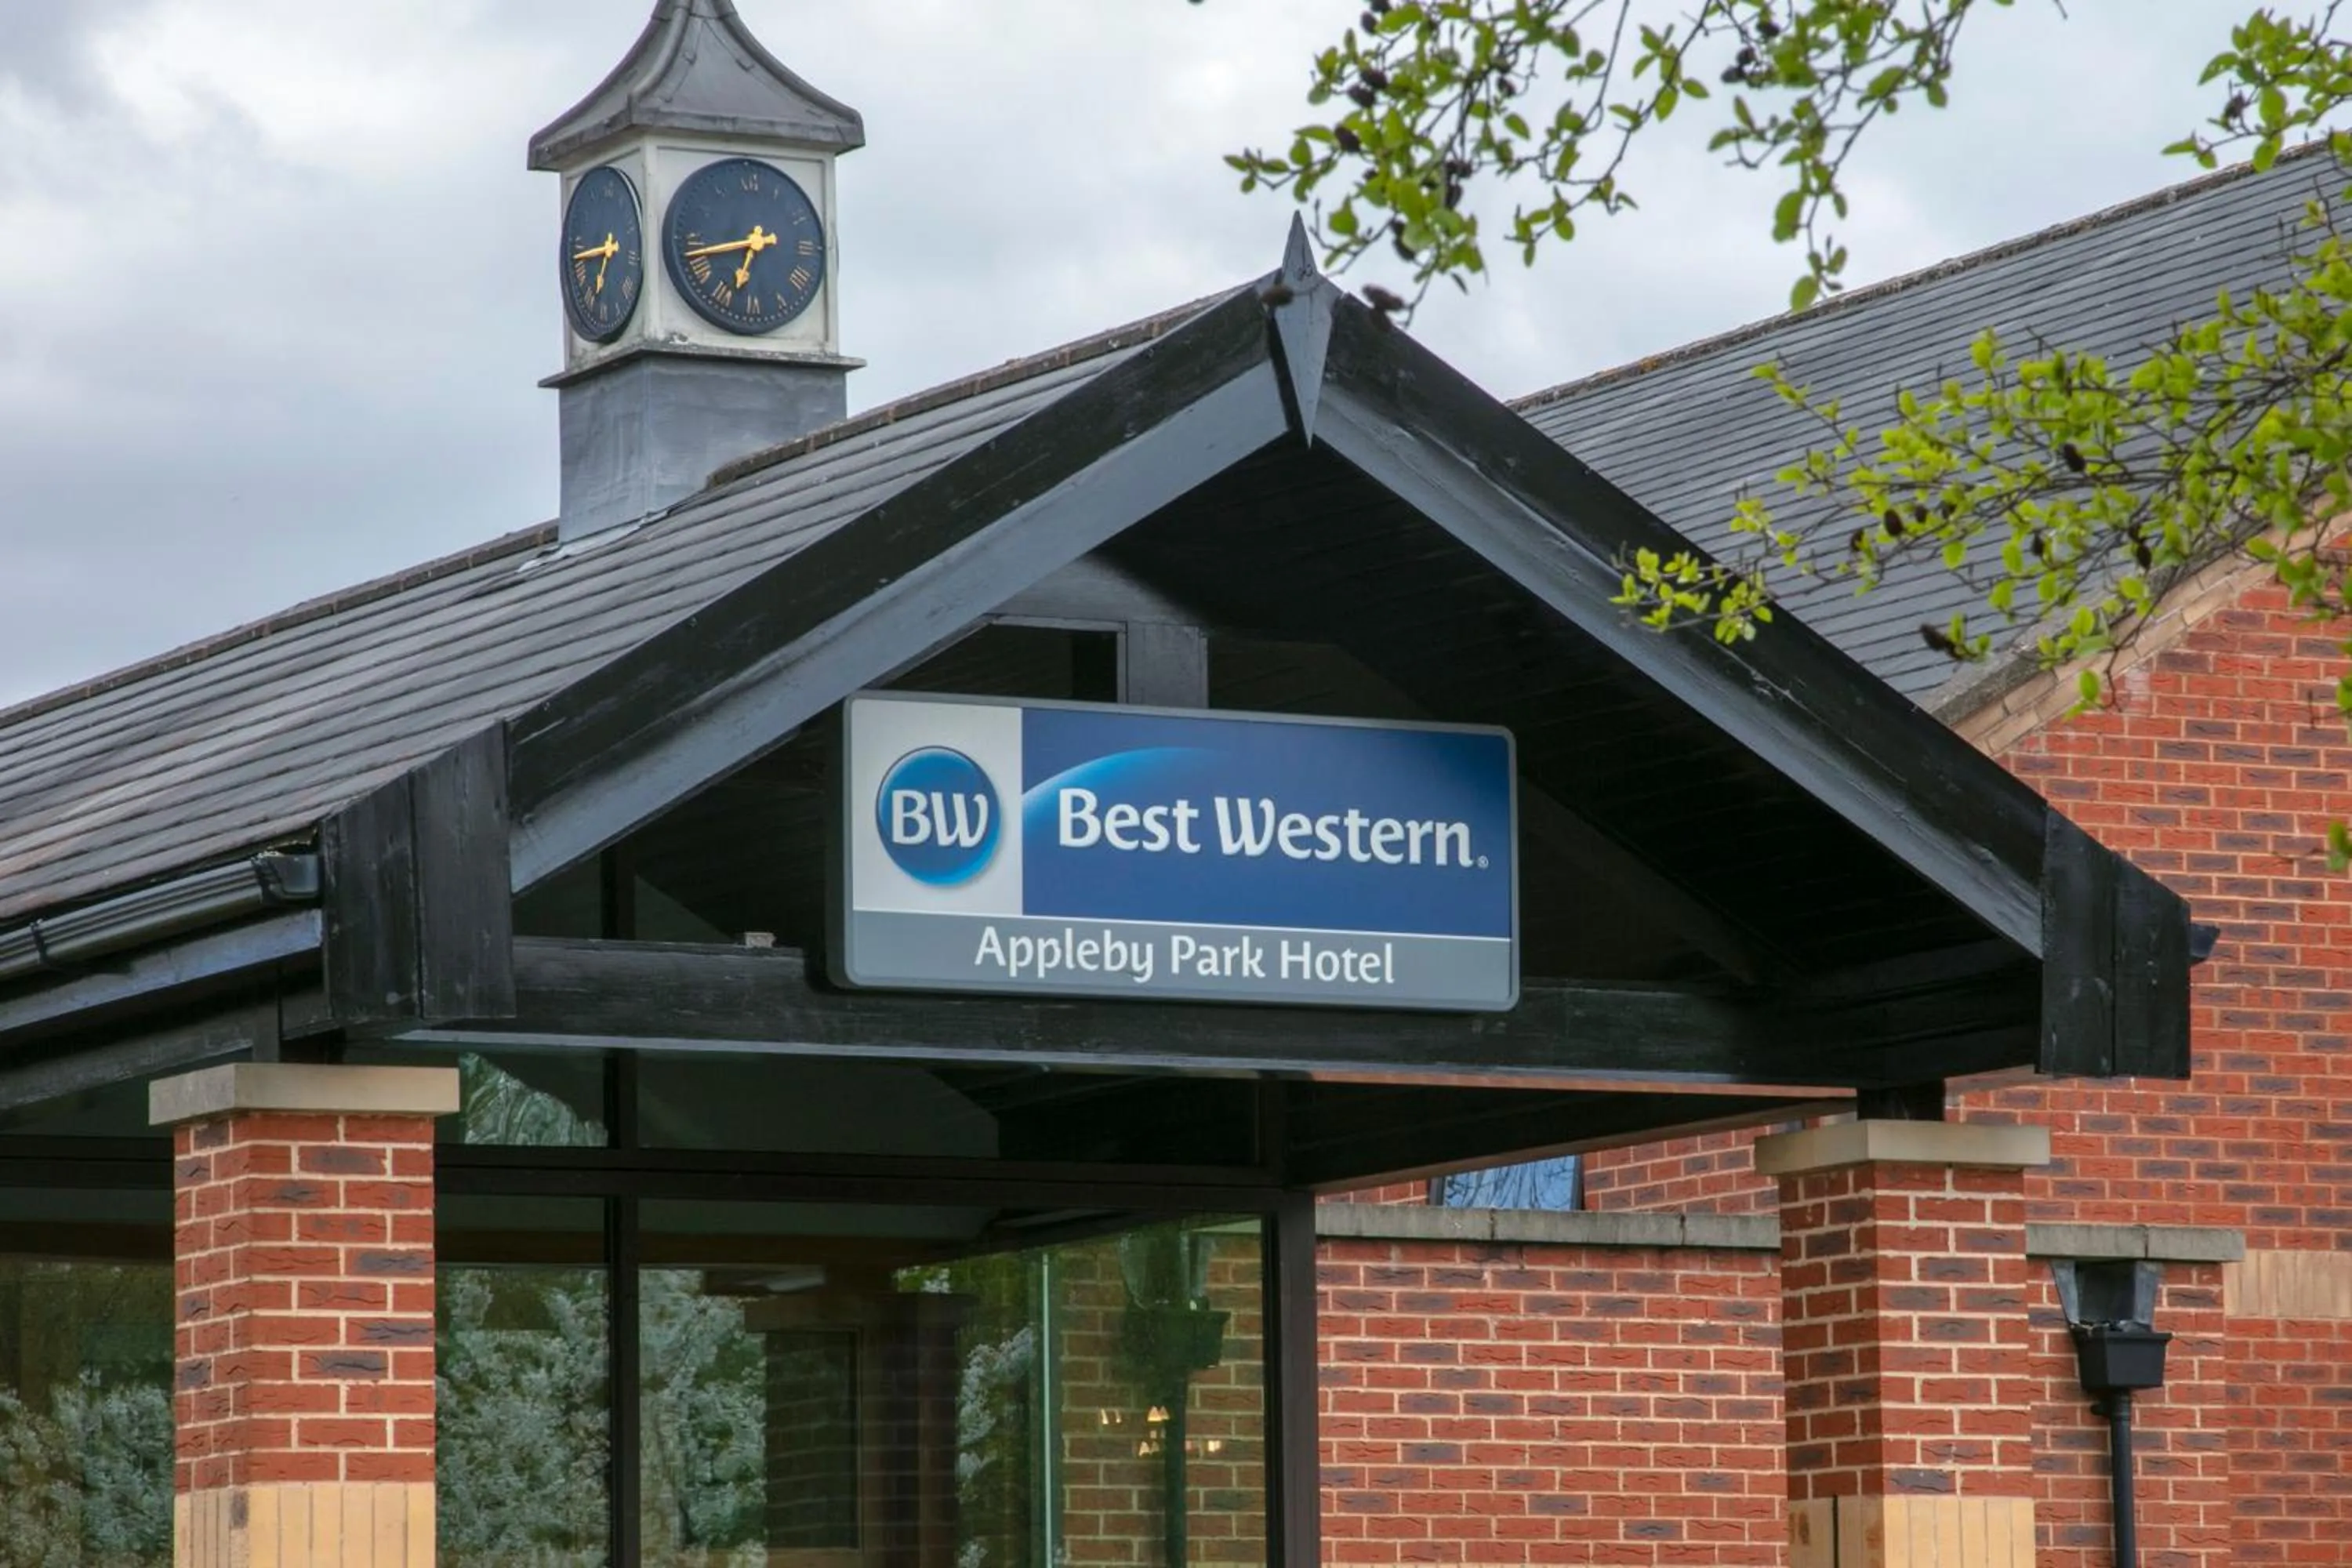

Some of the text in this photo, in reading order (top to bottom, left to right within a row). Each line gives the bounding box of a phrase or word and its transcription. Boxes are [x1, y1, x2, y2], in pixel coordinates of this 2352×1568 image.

[891, 789, 989, 848] BW
[1058, 787, 1475, 868] Best Western
[974, 925, 1396, 984] Appleby Park Hotel
